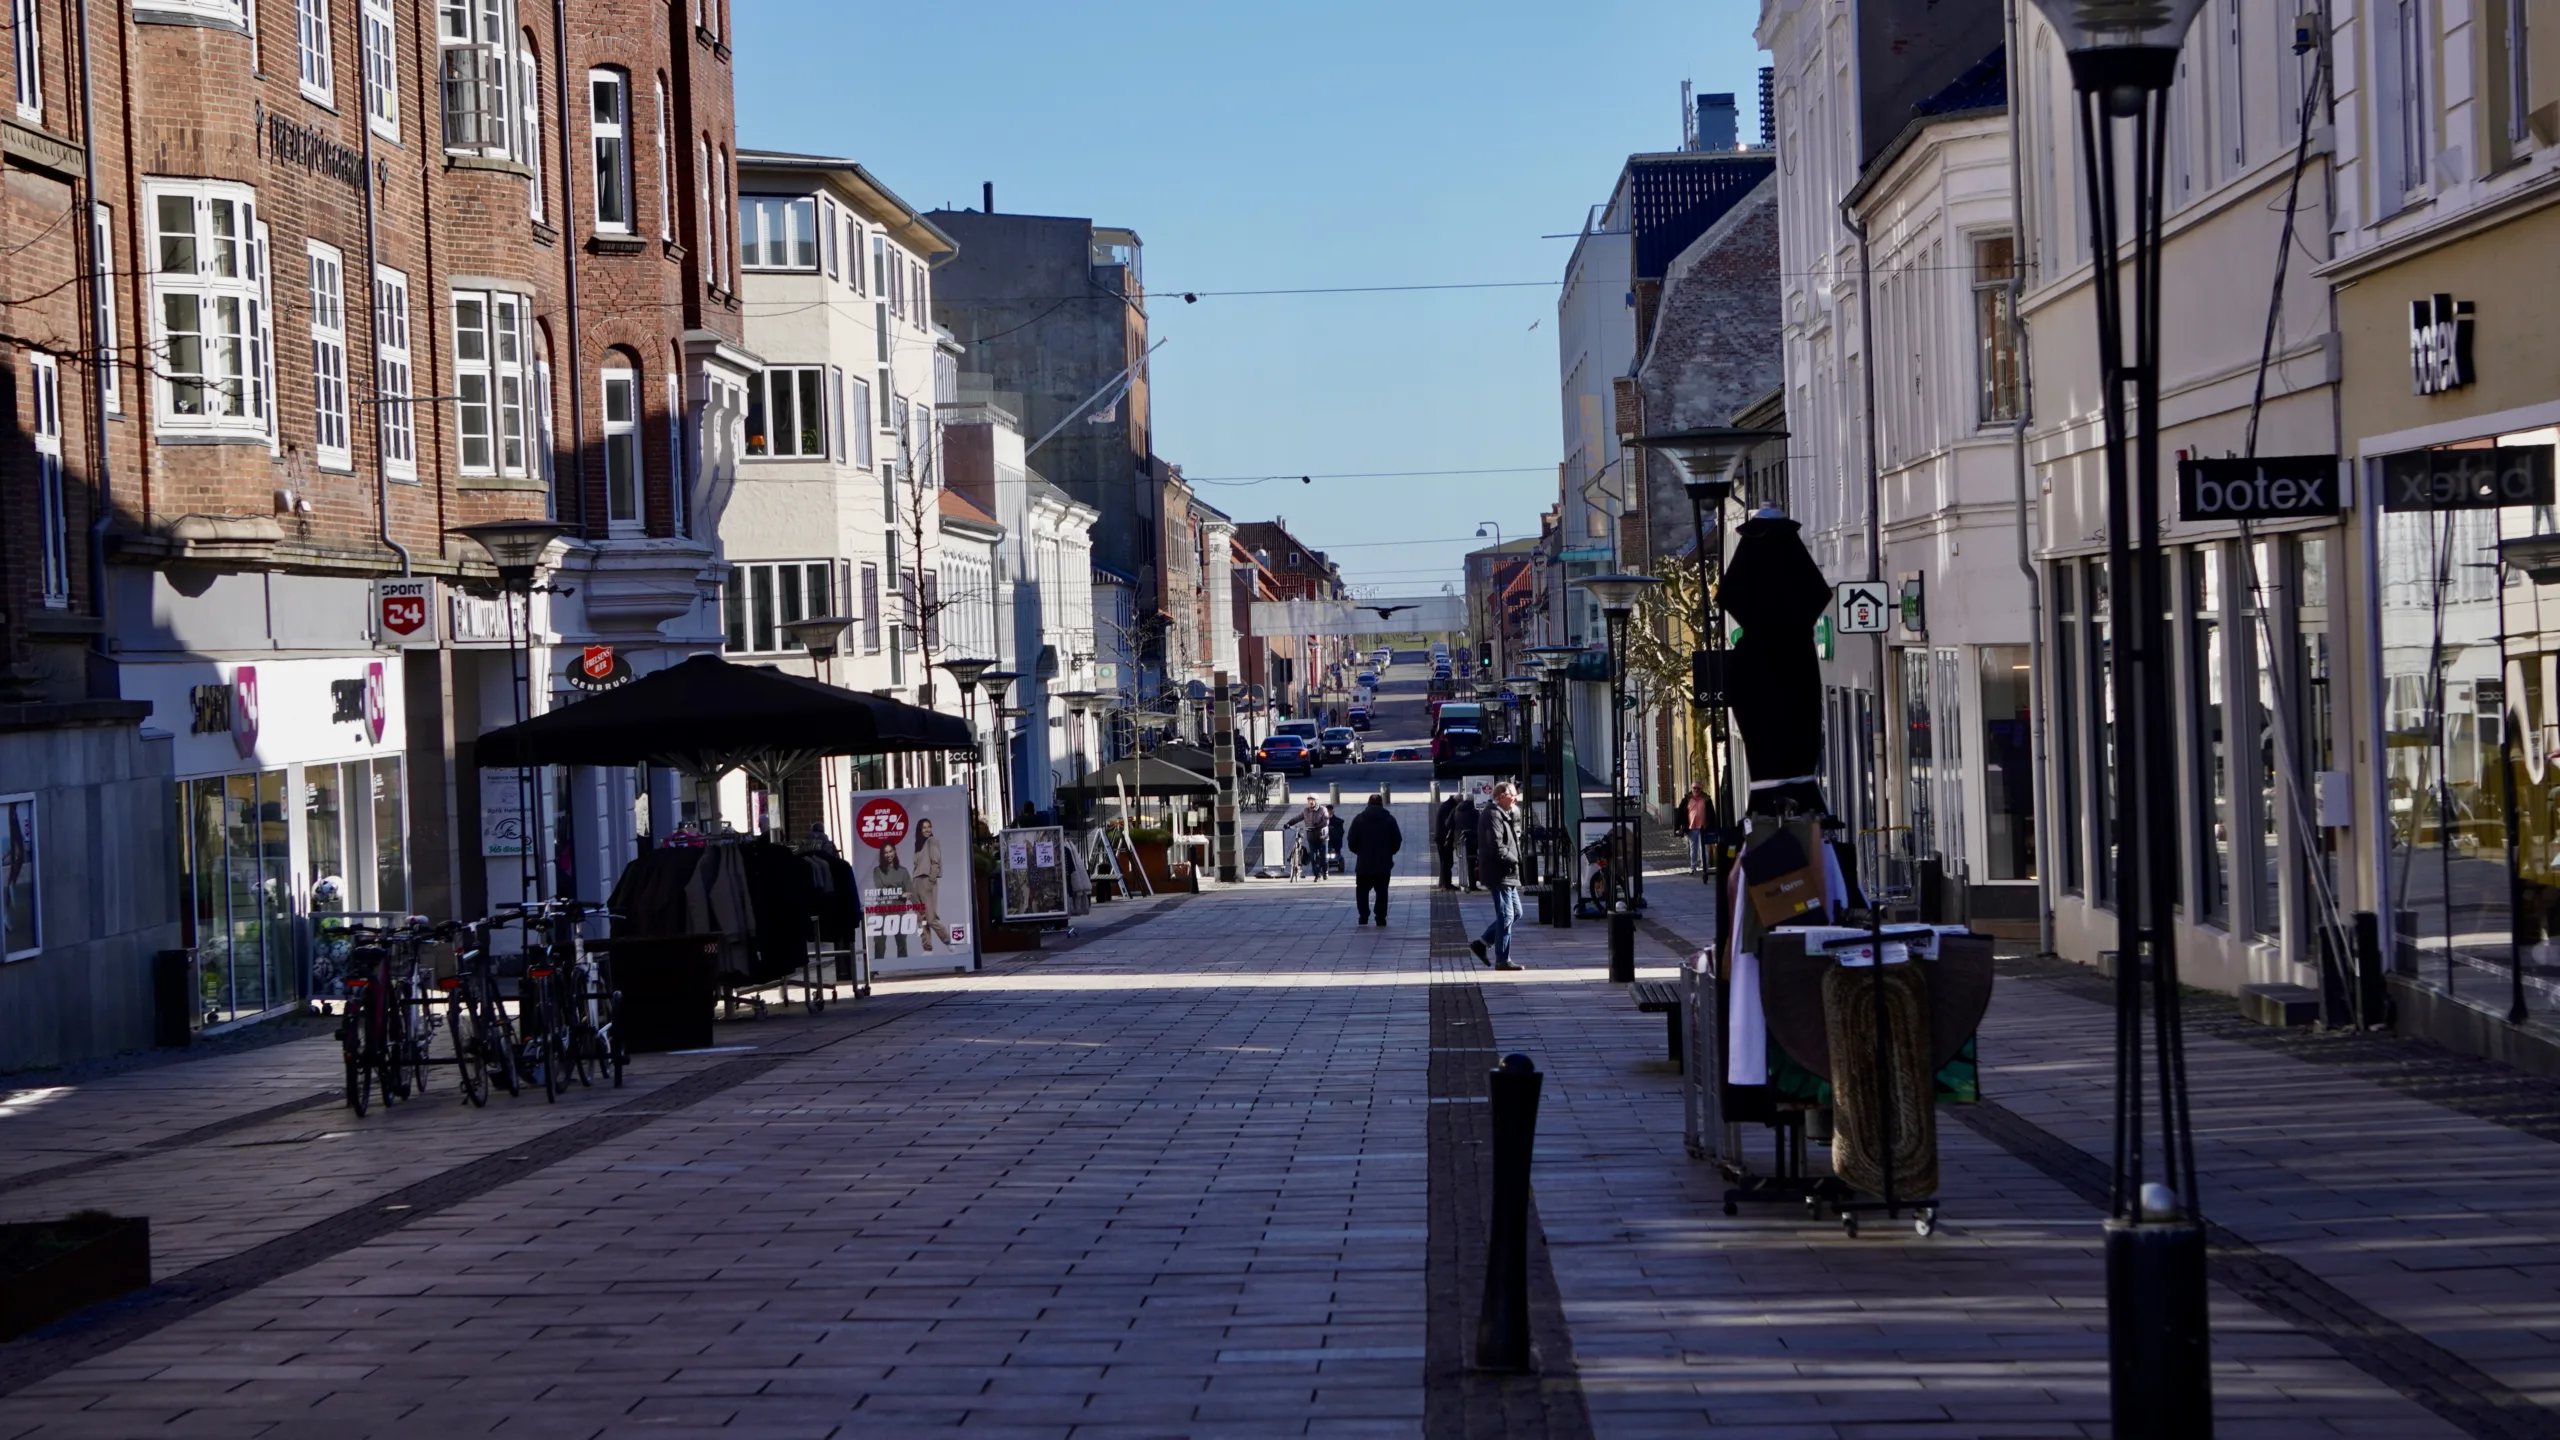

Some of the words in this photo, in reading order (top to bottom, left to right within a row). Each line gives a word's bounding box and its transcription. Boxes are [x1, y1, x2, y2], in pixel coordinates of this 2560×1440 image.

[2195, 465, 2325, 513] botex
[382, 584, 424, 596] SPORT
[388, 603, 422, 625] 24
[571, 676, 628, 691] GENBRUG
[861, 814, 905, 832] 33%
[488, 845, 502, 853] 365
[864, 888, 881, 896] FRIT
[882, 887, 903, 895] VALG
